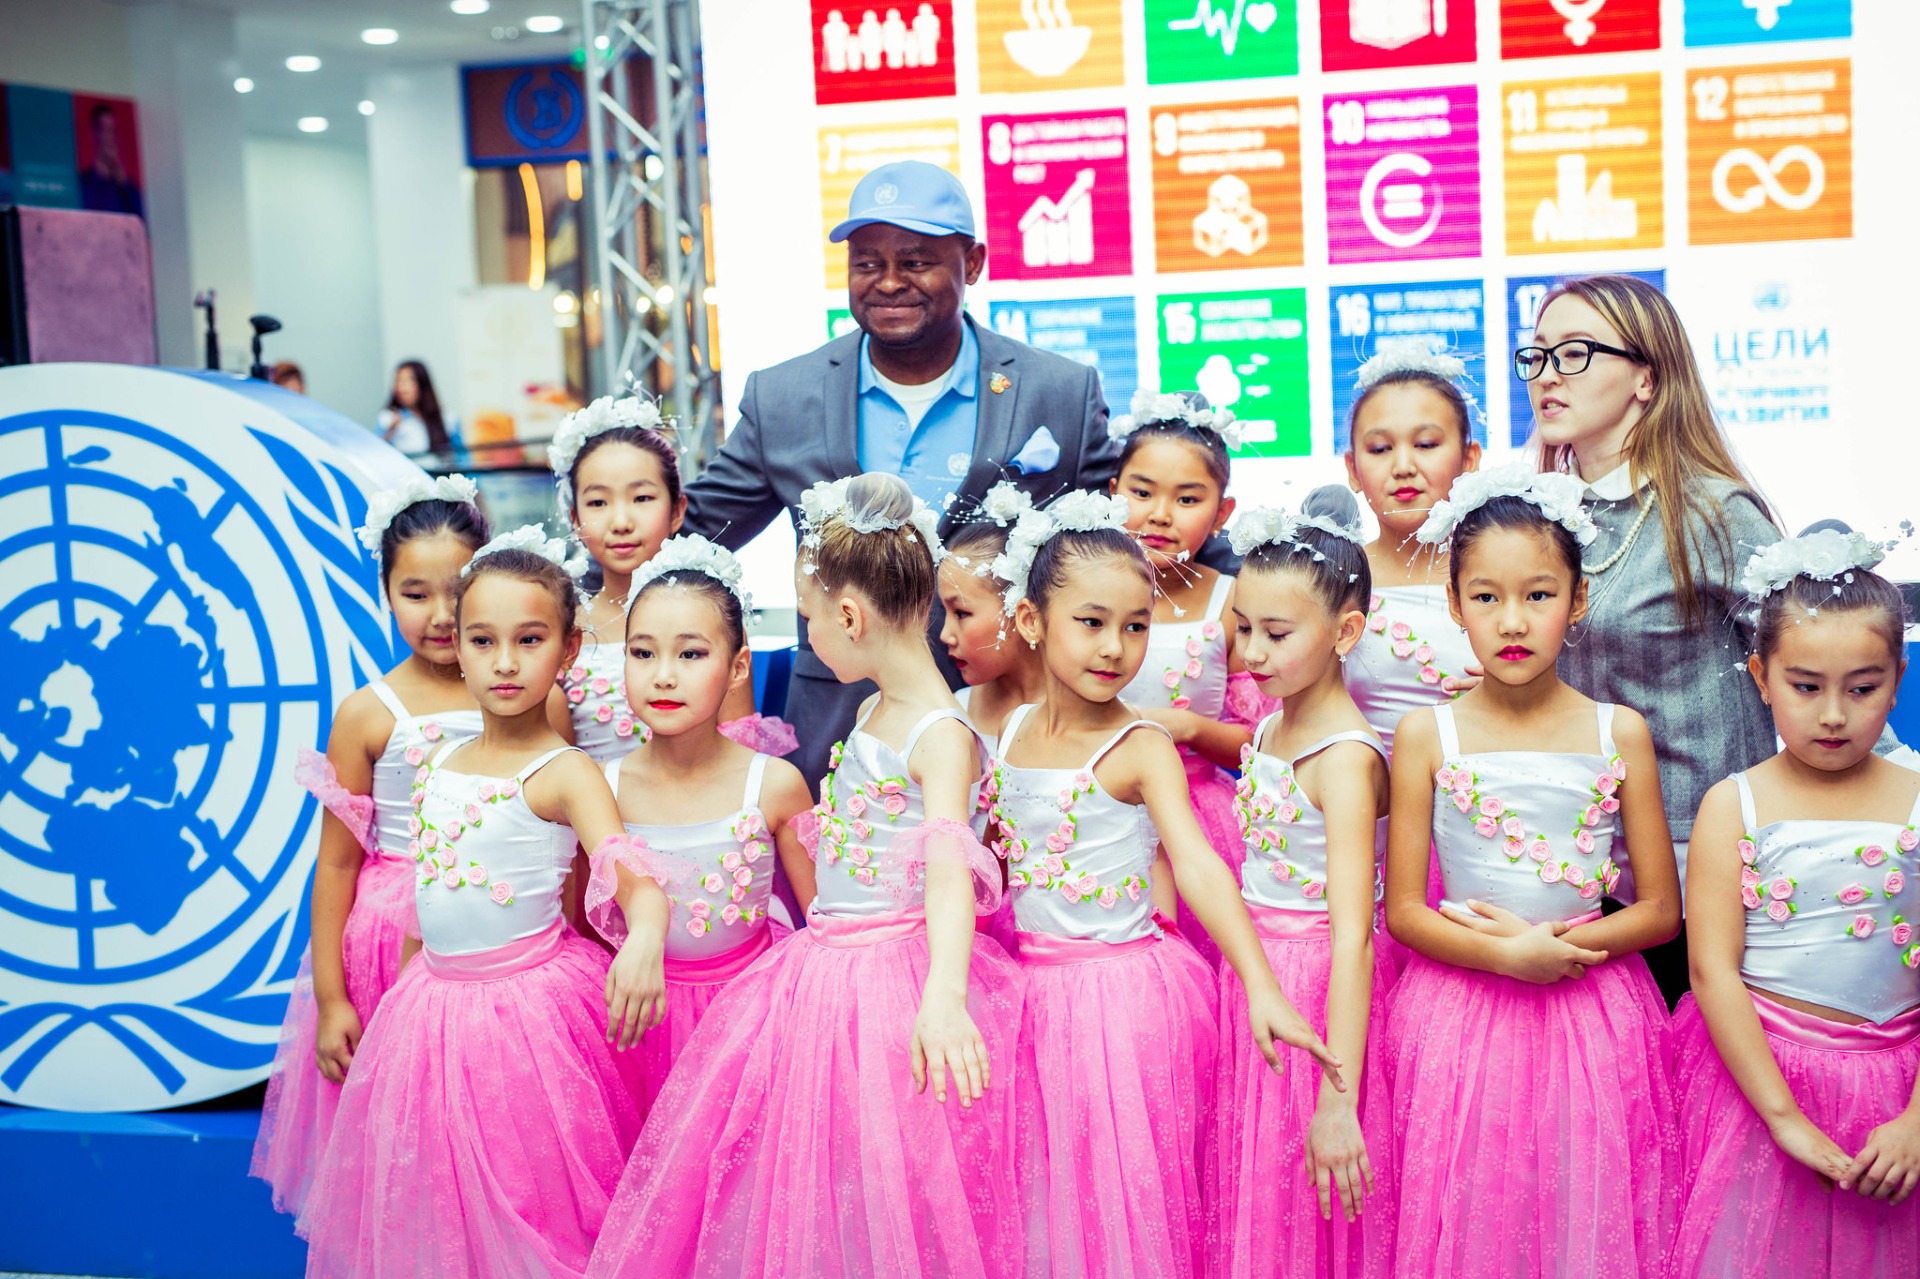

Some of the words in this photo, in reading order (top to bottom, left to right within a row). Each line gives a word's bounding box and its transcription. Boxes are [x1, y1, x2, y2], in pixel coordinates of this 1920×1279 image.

[1507, 89, 1537, 133] 11
[1692, 75, 1729, 121] 12
[988, 121, 1012, 165] 8
[1154, 112, 1178, 156] 9
[1328, 100, 1366, 145] 10
[1163, 302, 1196, 344] 15
[1336, 292, 1371, 336] 16
[1514, 284, 1547, 328] 17
[1713, 327, 1830, 367] ЦЕЛИ
